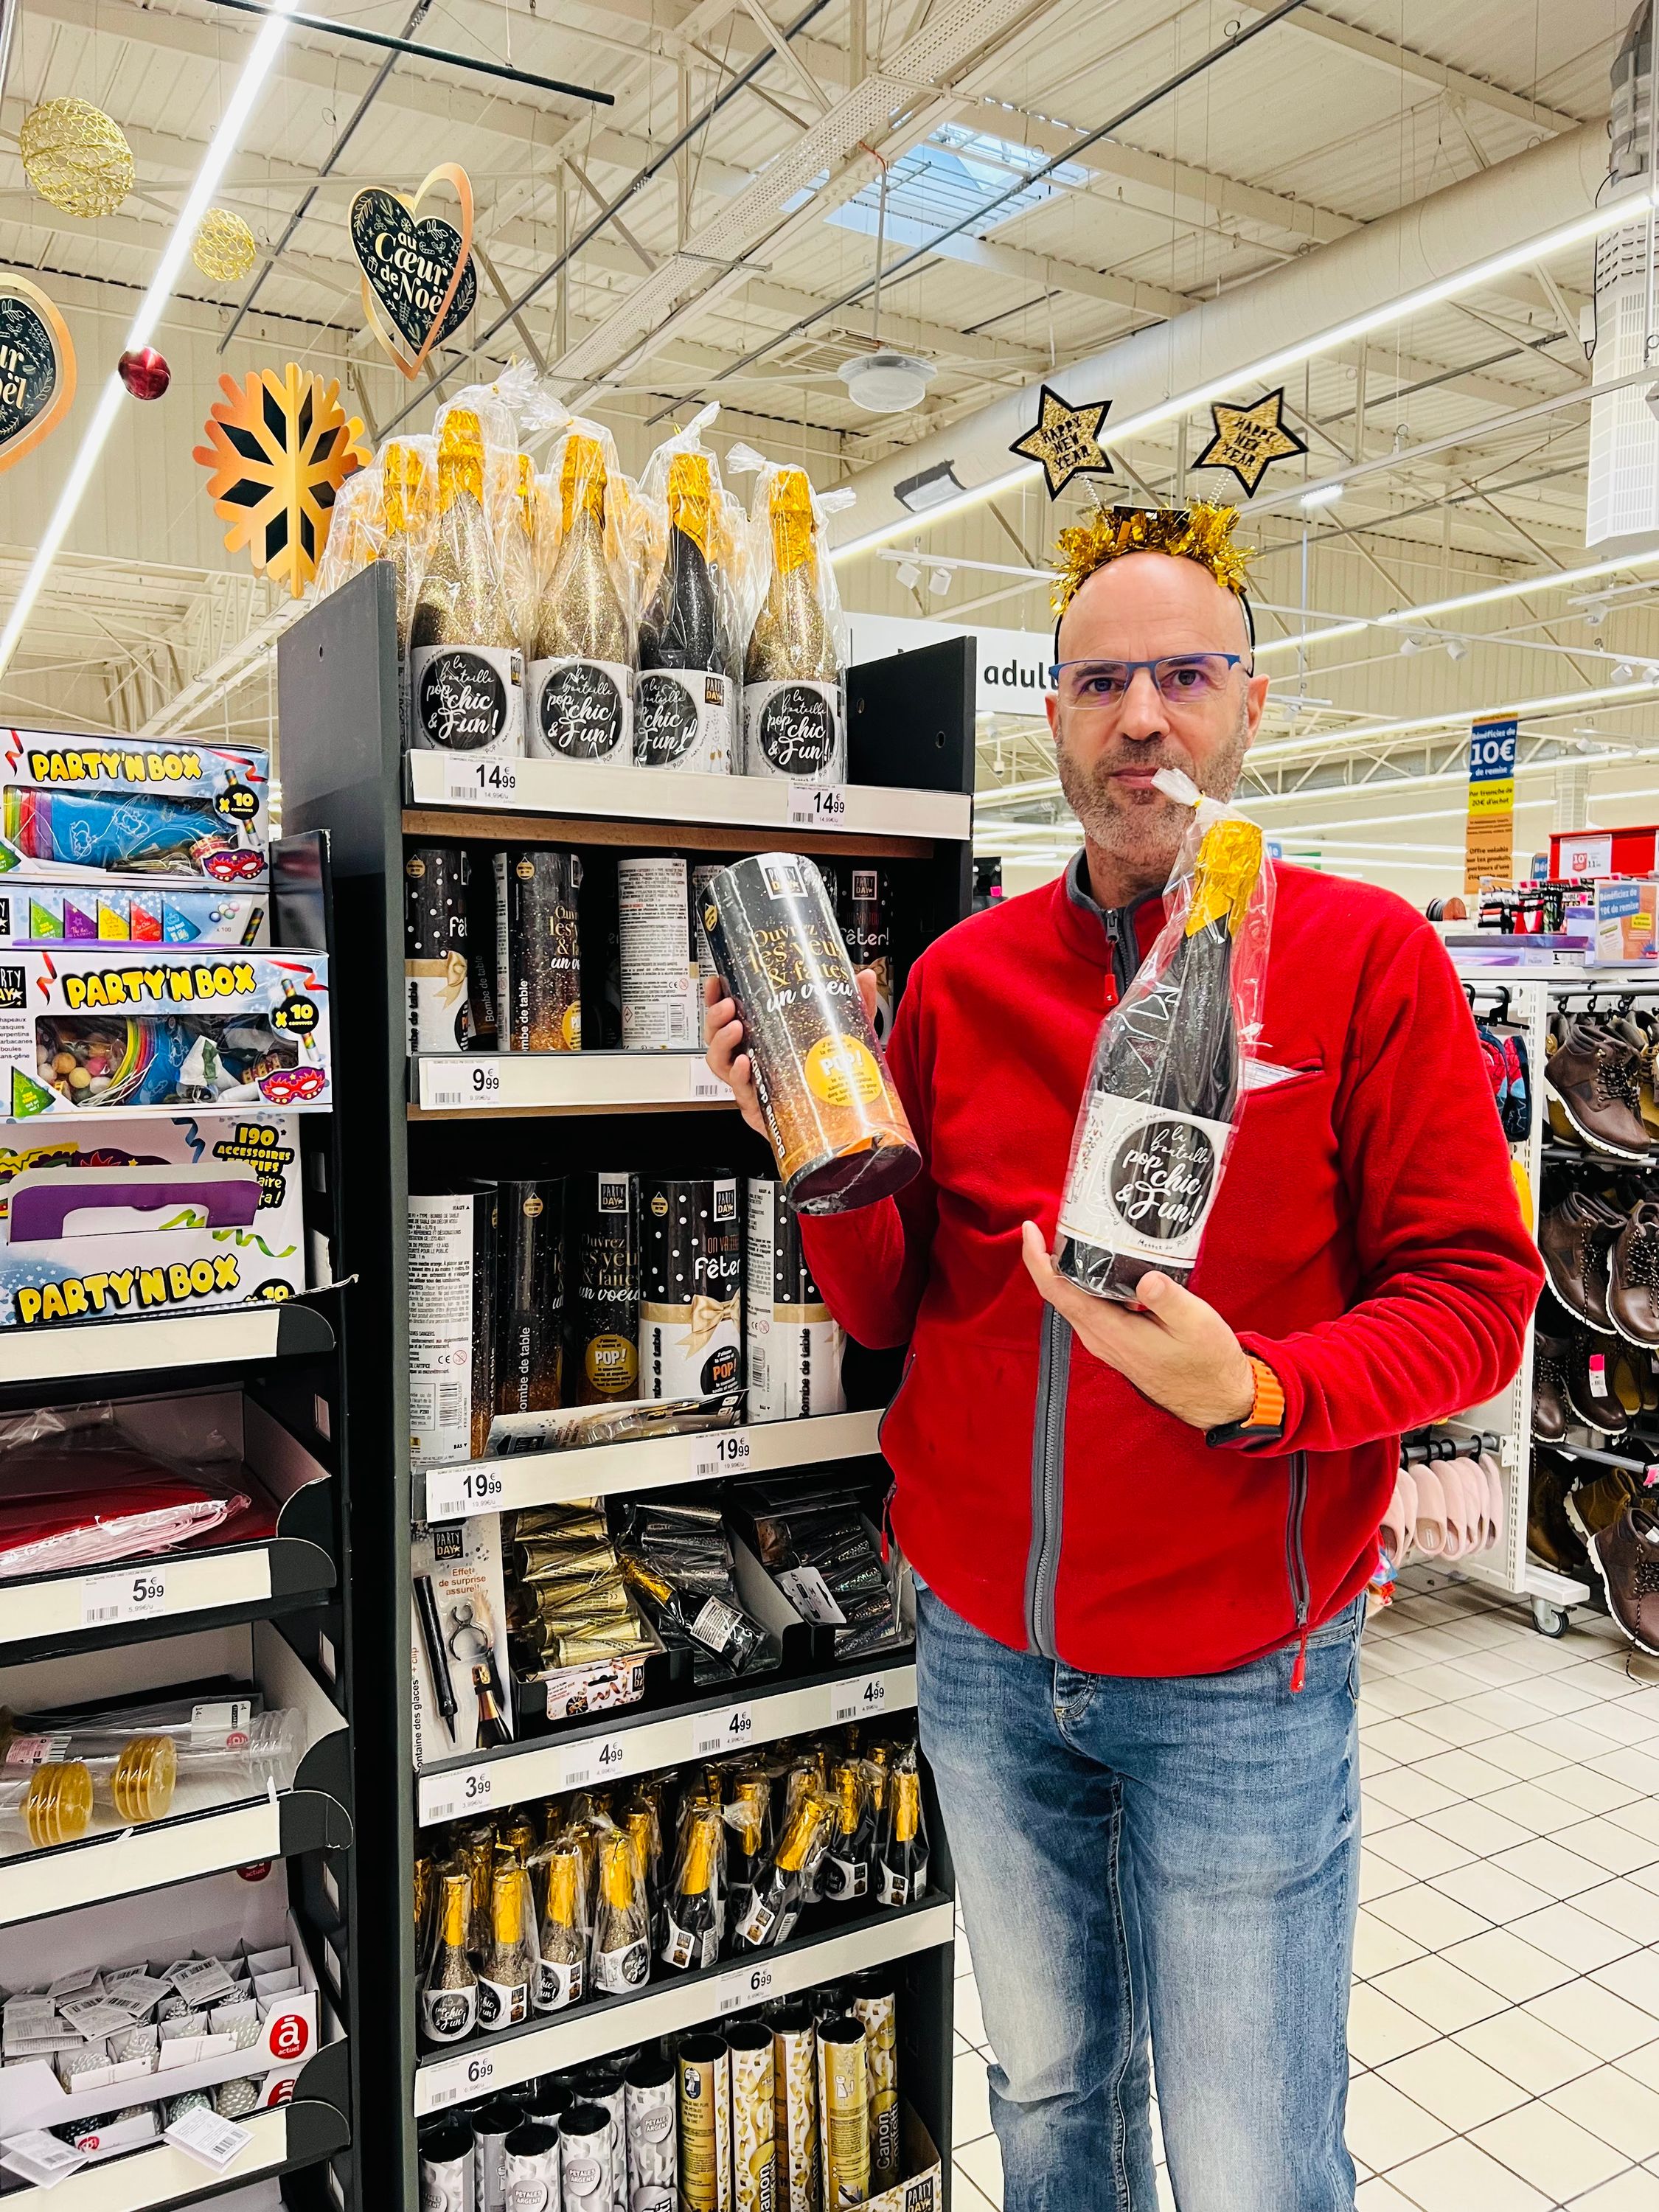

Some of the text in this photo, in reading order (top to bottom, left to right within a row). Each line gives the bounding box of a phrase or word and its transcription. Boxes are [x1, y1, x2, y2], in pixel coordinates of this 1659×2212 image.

[397, 232, 417, 251] au
[375, 232, 448, 285] Cœur
[380, 264, 399, 286] de
[393, 271, 448, 319] Noë
[1041, 416, 1082, 443] HAPPY
[1234, 417, 1277, 442] HAPPY
[1053, 432, 1079, 454] NEW
[1054, 445, 1091, 470] YEAR
[1222, 444, 1256, 467] YEAR
[453, 655, 466, 669] la
[575, 669, 588, 682] la
[427, 684, 452, 701] pop
[447, 686, 494, 709] chic
[547, 694, 574, 712] pop
[568, 697, 611, 721] chic
[428, 712, 437, 728] &
[645, 704, 684, 728] chic
[768, 715, 793, 731] pop
[548, 722, 557, 737] &
[787, 716, 826, 738] chic
[768, 740, 778, 756] &
[1471, 738, 1515, 765] 10€
[147, 752, 203, 780] BOX
[232, 792, 254, 807] 10
[557, 939, 568, 956] &
[0, 968, 21, 988] RTY
[196, 964, 257, 996] BOX
[769, 968, 791, 990] &
[290, 1004, 313, 1019] 10
[408, 981, 419, 1026] de table
[519, 979, 529, 1026] de table
[239, 1127, 275, 1146] 190
[765, 1105, 786, 1158] Bombe
[1171, 1124, 1187, 1142] la
[217, 1145, 291, 1161] ACCESSOIRES
[1151, 1128, 1209, 1164] bouteille
[1122, 1149, 1163, 1174] pop
[258, 1175, 282, 1188] aire
[1151, 1163, 1201, 1195] chic
[602, 1185, 625, 1197] PARTY
[1115, 1183, 1133, 1202] &
[602, 1197, 620, 1206] DAY
[718, 1204, 731, 1214] DAY
[602, 1252, 638, 1273] yeu
[170, 1253, 240, 1299] BOX
[520, 1327, 531, 1357] table
[653, 1327, 661, 1375] de table
[799, 1328, 810, 1357] table
[520, 1357, 529, 1374] de
[799, 1360, 810, 1376] de
[437, 1531, 459, 1546] PARTY
[437, 1545, 456, 1556] DAY
[451, 1576, 486, 1585] surprise
[452, 1568, 472, 1576] Effet
[411, 1646, 420, 1664] clip
[411, 1679, 422, 1711] glaces
[414, 1733, 423, 1770] ontaine
[245, 1867, 265, 1879] actuel
[278, 2045, 300, 2056] actuel
[876, 2112, 891, 2170] Canon
[569, 2168, 596, 2177] PETALES
[515, 2190, 542, 2199] PETALES
[759, 2164, 771, 2212] anon
[908, 2180, 931, 2204] PARTY
[516, 2197, 541, 2205] ARGENT
